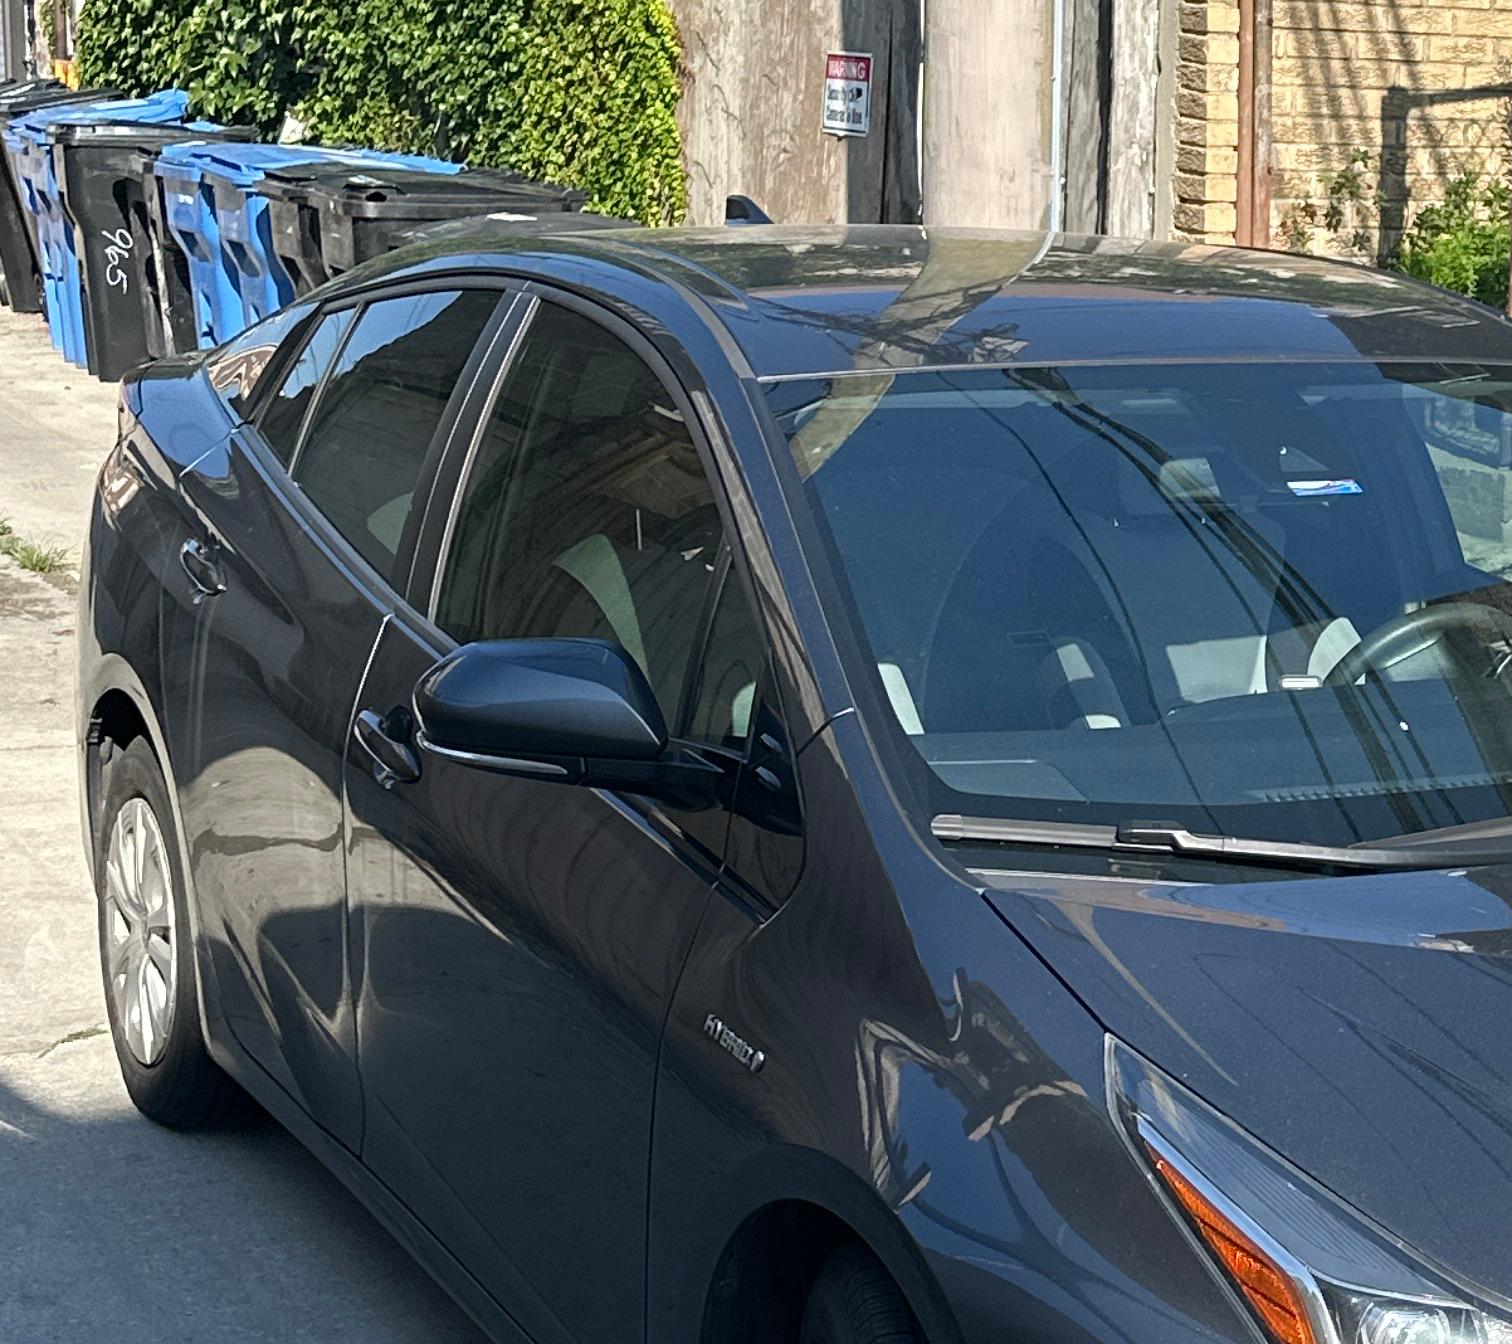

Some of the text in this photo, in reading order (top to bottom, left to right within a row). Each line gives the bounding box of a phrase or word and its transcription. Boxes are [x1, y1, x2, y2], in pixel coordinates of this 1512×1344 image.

[828, 60, 866, 80] WARNING
[100, 227, 134, 295] 965
[703, 1013, 754, 1066] HYBRID
